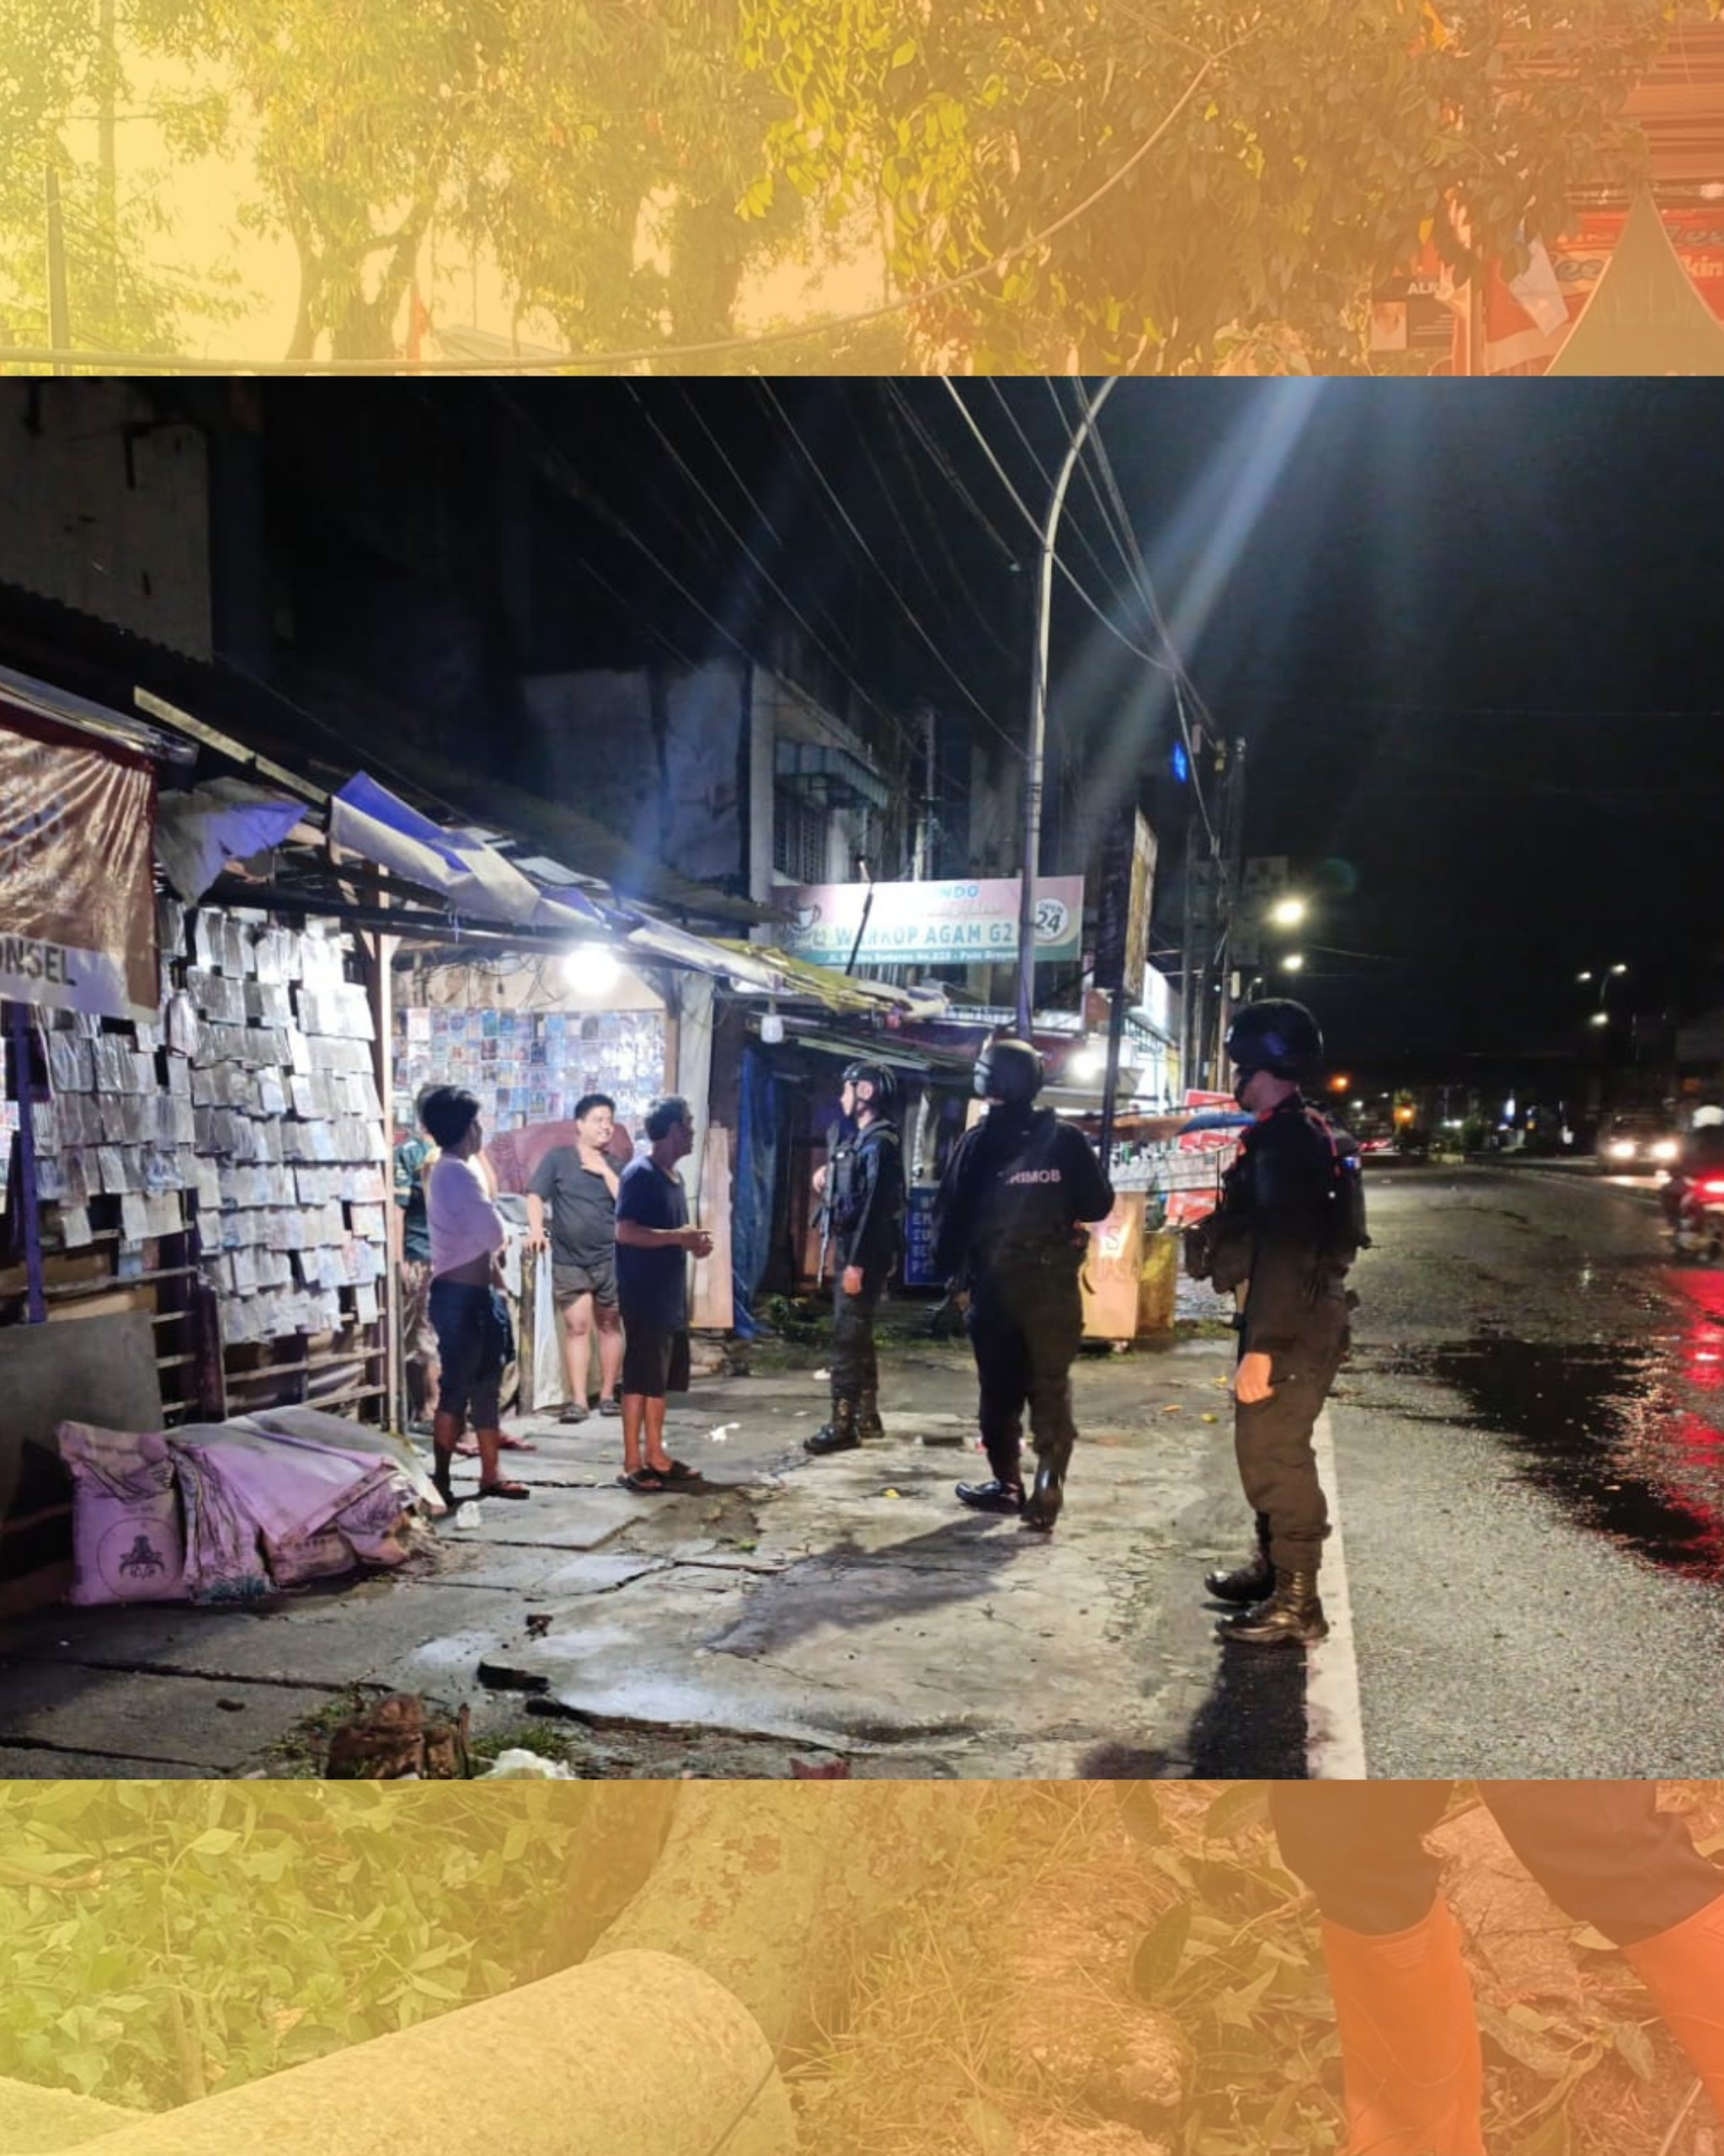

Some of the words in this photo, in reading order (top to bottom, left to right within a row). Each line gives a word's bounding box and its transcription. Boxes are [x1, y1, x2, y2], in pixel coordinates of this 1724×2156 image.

[1036, 910, 1060, 933] 24
[925, 923, 980, 943] AGAM
[990, 923, 1013, 942] G2
[1006, 1168, 1062, 1184] RIMOB
